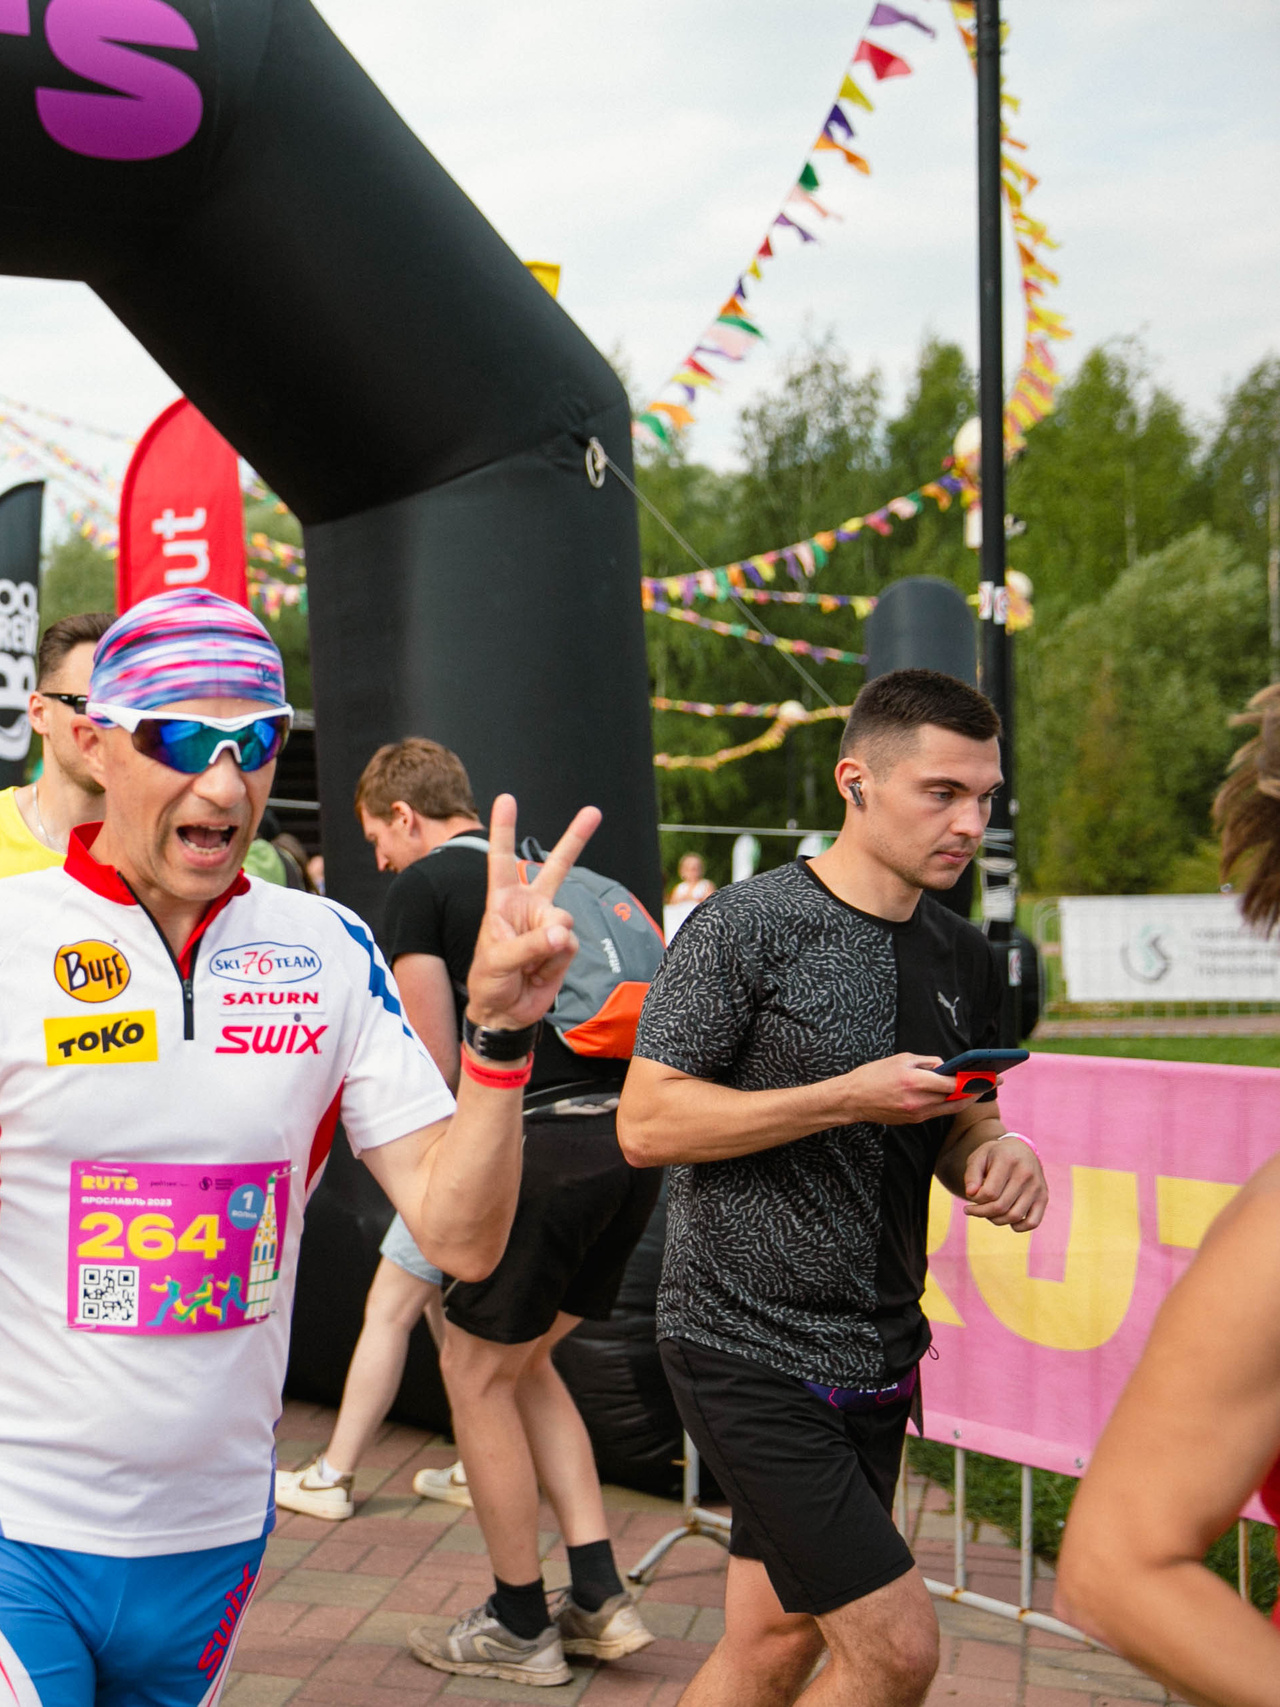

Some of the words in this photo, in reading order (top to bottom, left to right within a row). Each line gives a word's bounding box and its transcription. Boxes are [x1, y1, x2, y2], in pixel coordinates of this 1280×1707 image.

[215, 958, 240, 971] SKI
[242, 949, 275, 975] 76
[274, 956, 316, 969] TEAM
[222, 992, 319, 1005] SATURN
[58, 1019, 144, 1058] TOKO
[81, 1175, 138, 1191] RUTS
[242, 1191, 254, 1210] 1
[77, 1211, 226, 1261] 264
